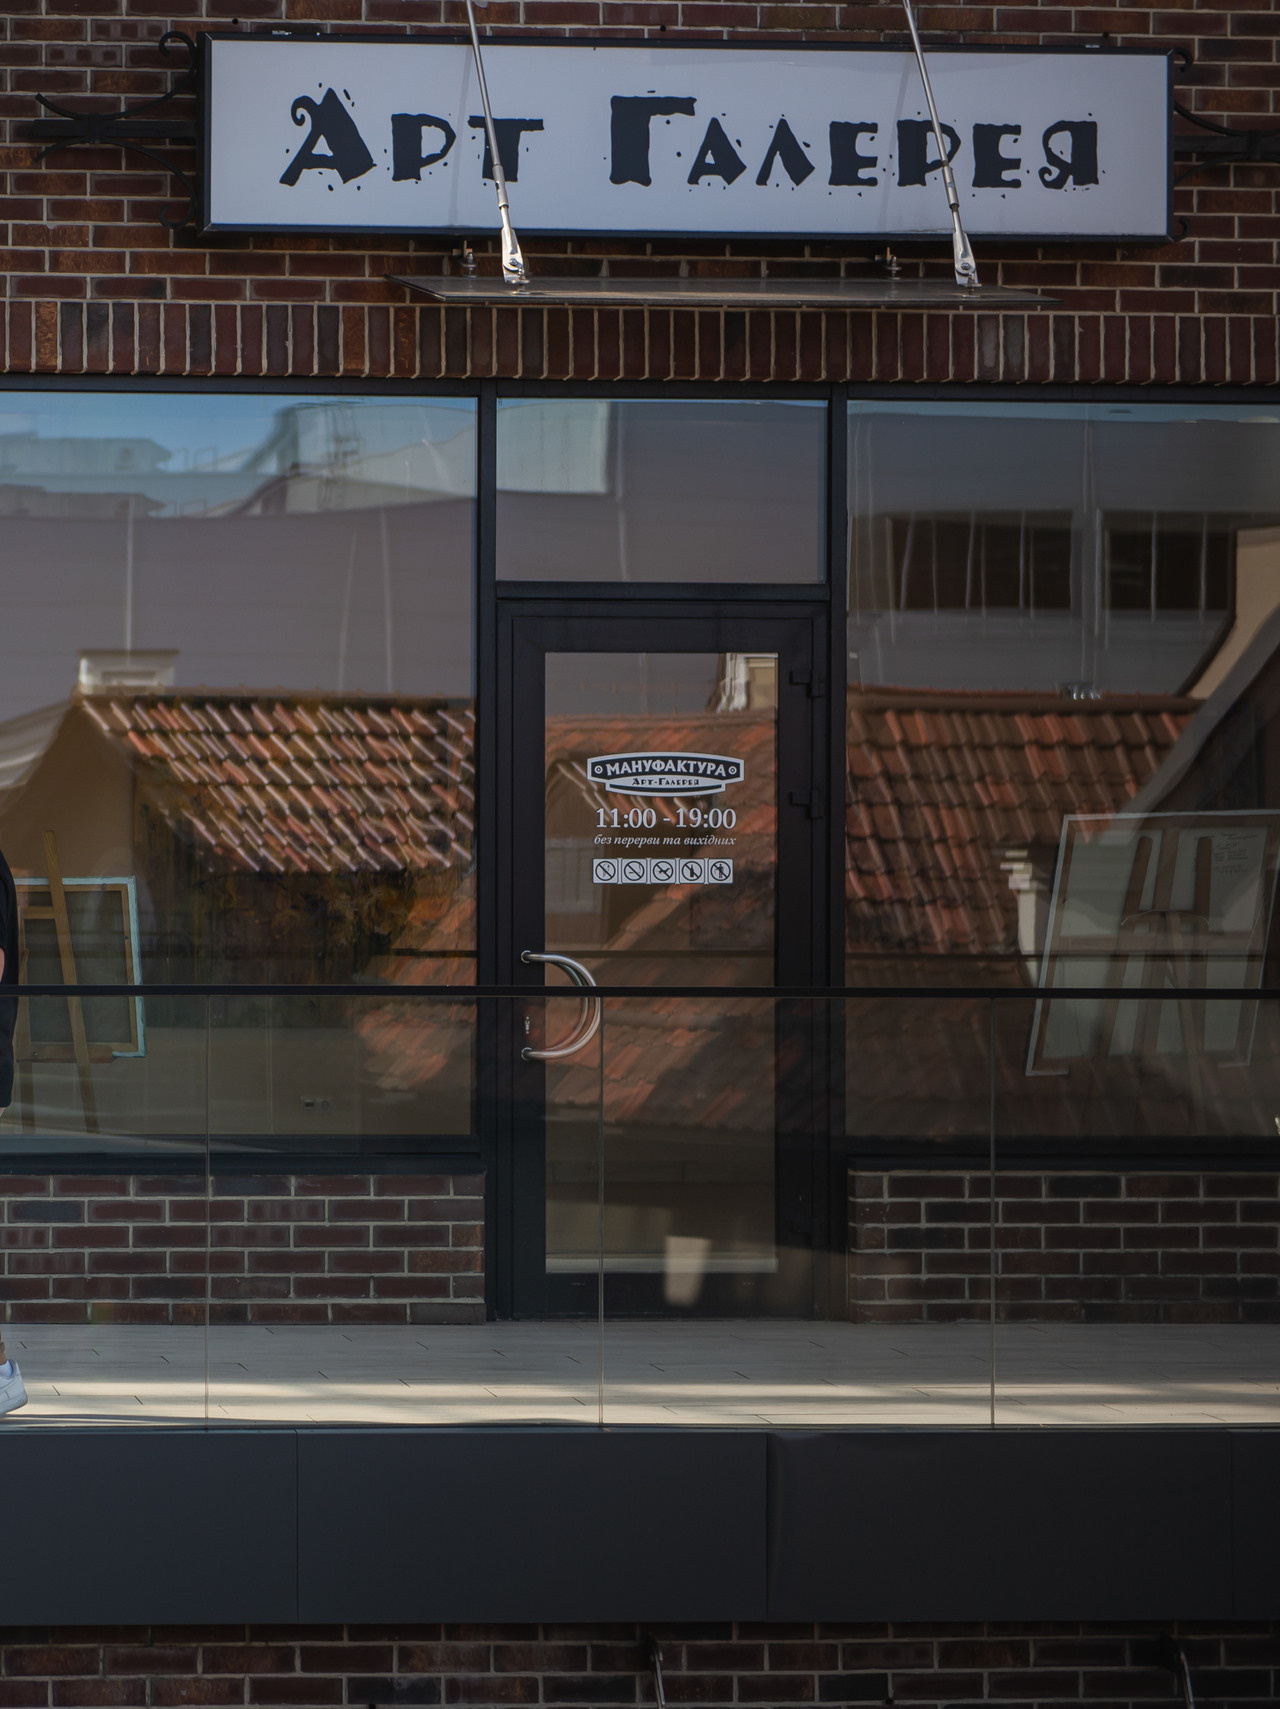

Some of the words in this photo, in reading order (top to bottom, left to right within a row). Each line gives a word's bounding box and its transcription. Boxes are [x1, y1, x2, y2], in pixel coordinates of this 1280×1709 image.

[606, 760, 726, 776] МАНУФАКТУРА
[596, 808, 656, 829] 11:00
[676, 808, 736, 829] 19:00
[594, 834, 612, 845] без
[613, 836, 660, 848] перерви
[662, 836, 681, 845] та
[683, 834, 737, 845] вихідних
